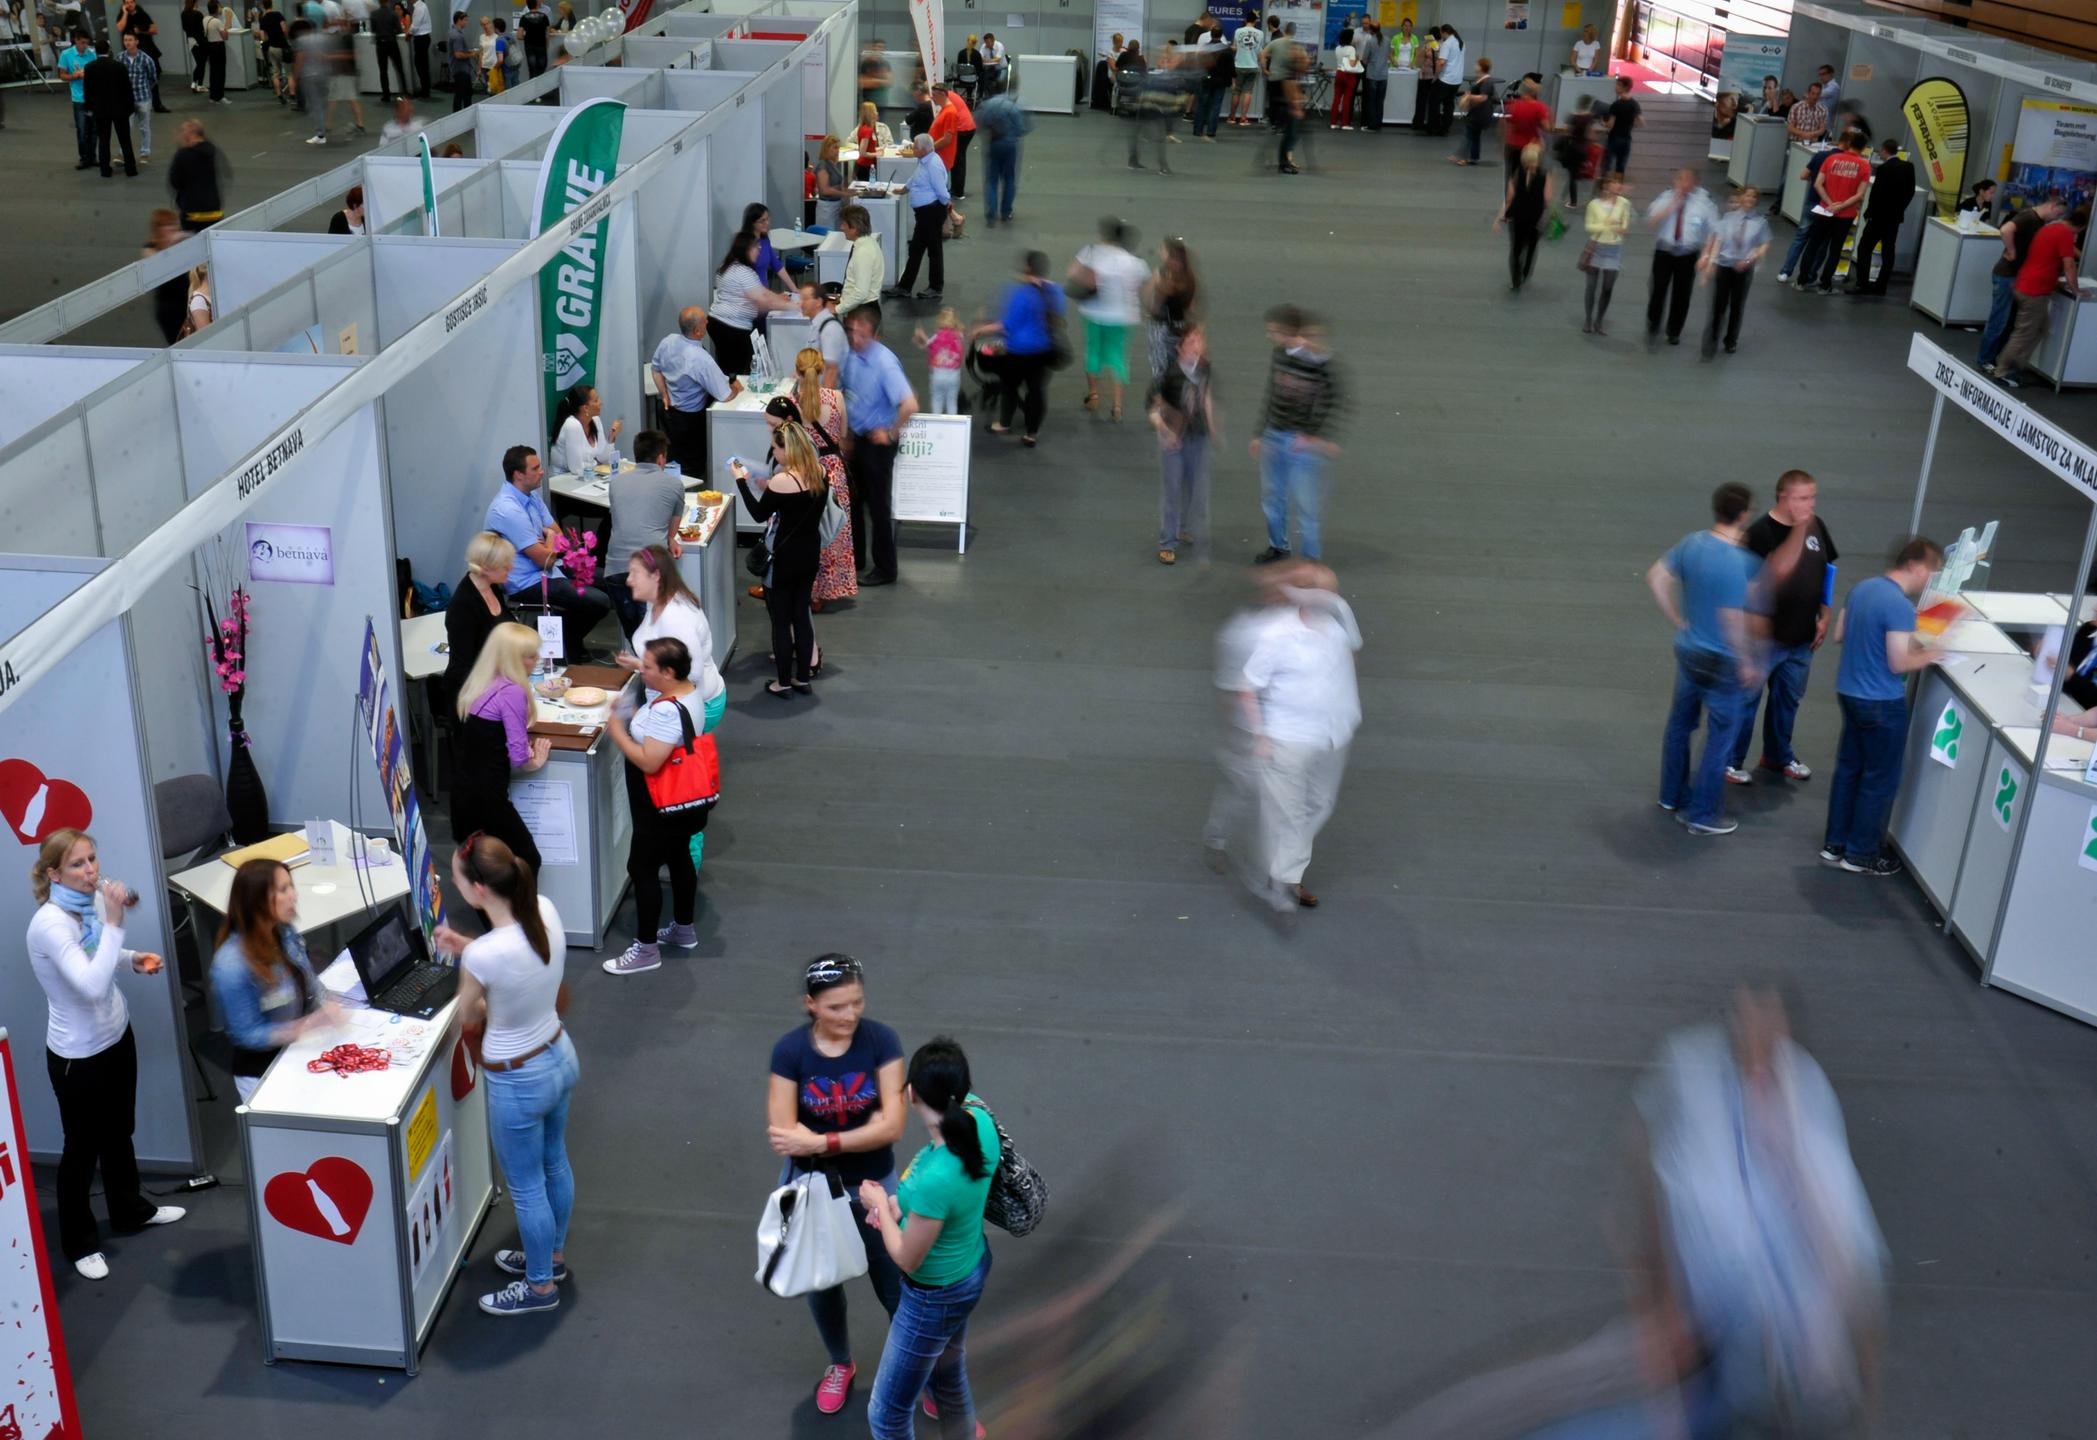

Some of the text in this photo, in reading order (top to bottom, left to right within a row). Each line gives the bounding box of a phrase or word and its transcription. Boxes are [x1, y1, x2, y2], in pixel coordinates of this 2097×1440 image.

[1208, 6, 1243, 16] EURES
[1935, 361, 1955, 388] ZRSZ
[1960, 379, 2012, 429] INFORMACIJE
[2017, 419, 2059, 461] JAMSTVO
[2059, 446, 2071, 472] ZA
[910, 430, 927, 439] vaši
[899, 441, 933, 458] cilji?
[237, 428, 304, 500] HOTEL BETNAVA
[276, 546, 328, 561] betnava
